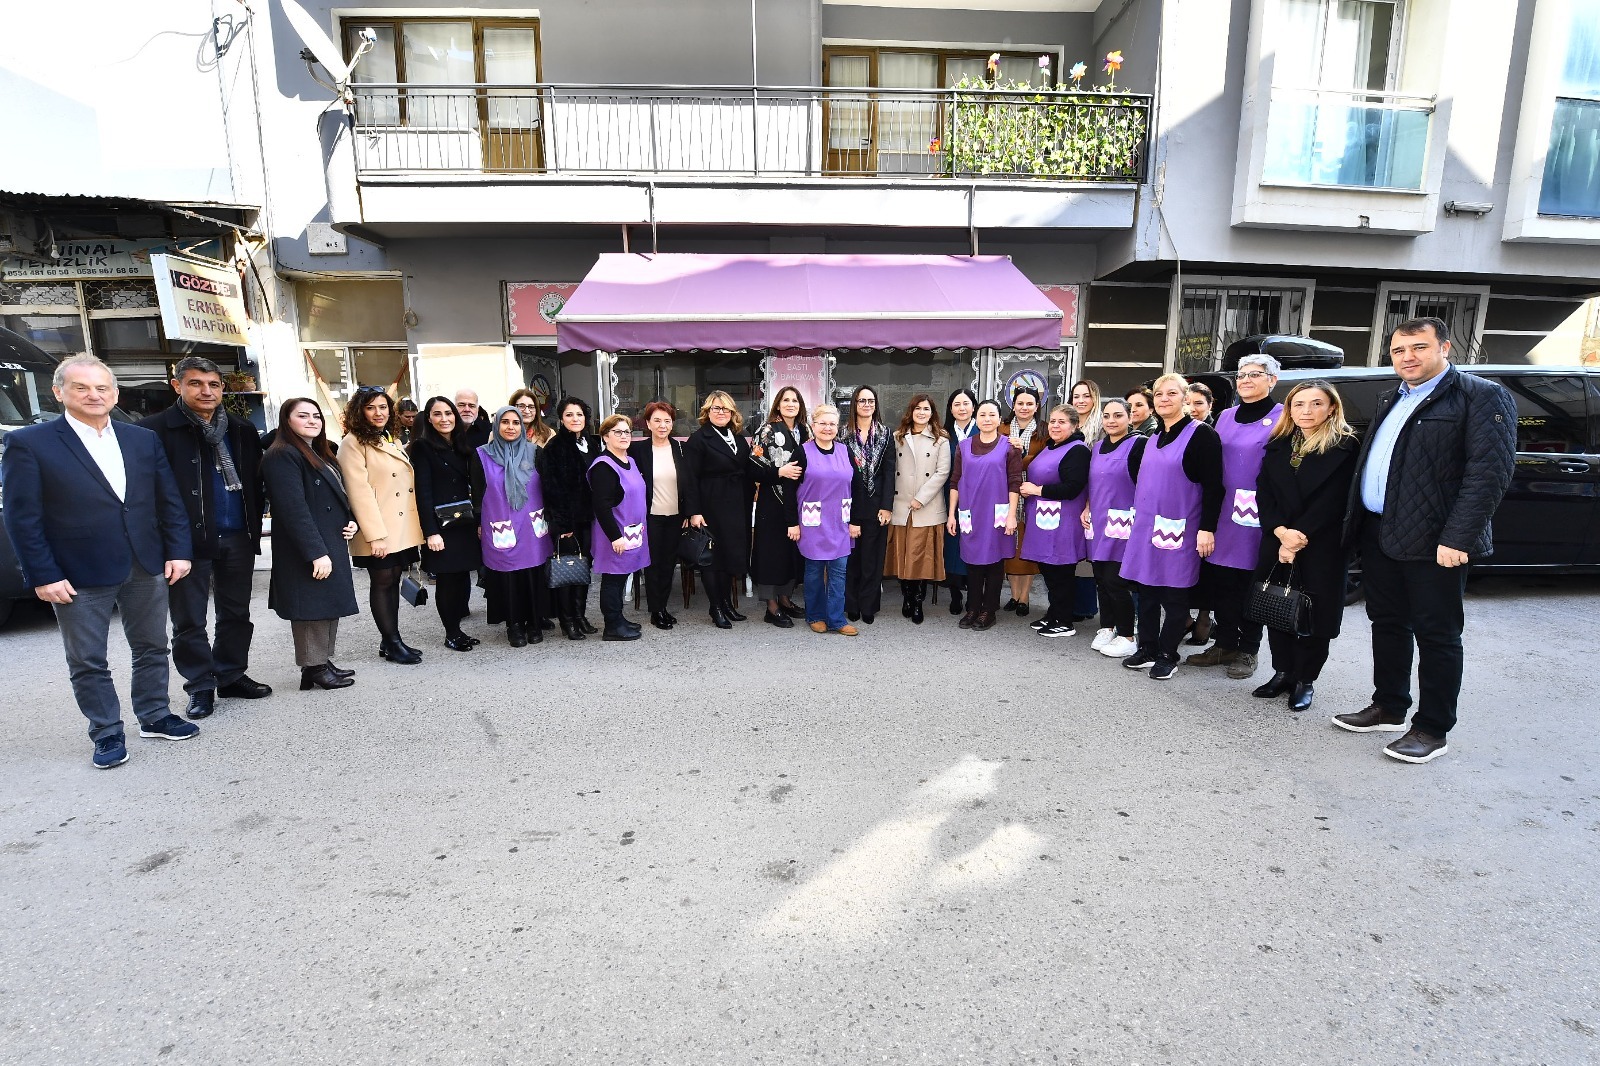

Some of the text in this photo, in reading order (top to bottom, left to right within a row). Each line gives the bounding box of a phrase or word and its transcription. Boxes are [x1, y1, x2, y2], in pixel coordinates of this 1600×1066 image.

[179, 274, 231, 296] GÖZDE
[187, 298, 231, 318] ERKEK
[780, 373, 815, 381] BAKLAVA
